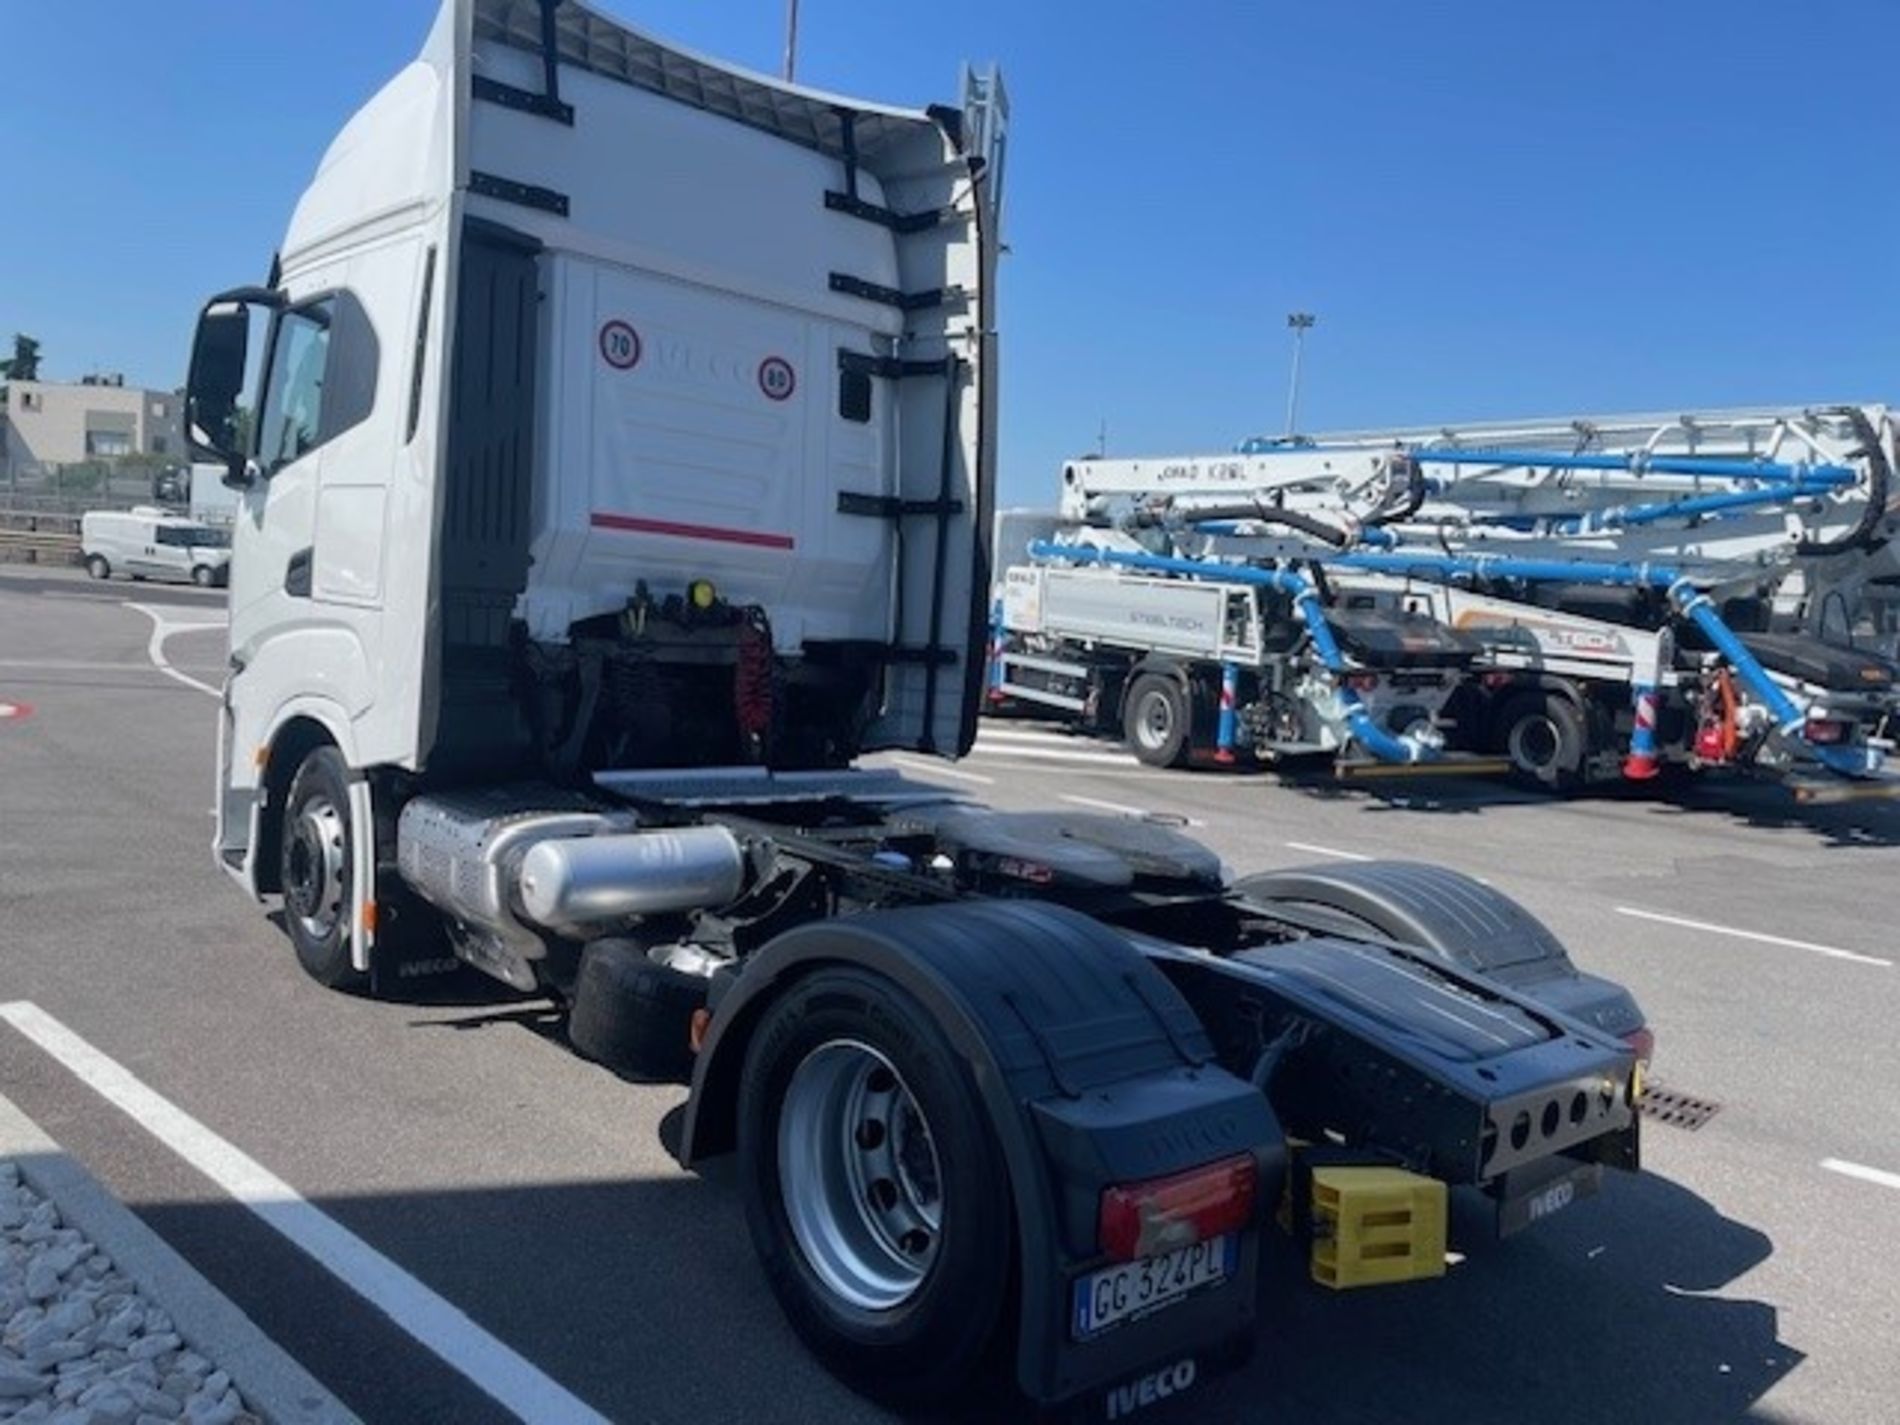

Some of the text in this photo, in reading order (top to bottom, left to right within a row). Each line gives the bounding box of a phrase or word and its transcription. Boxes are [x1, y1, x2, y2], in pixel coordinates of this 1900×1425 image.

[610, 332, 630, 357] 70
[768, 368, 786, 388] 80
[399, 958, 459, 977] IVECO
[1095, 1272, 1128, 1320] GG
[1139, 1238, 1219, 1300] 324PL
[1107, 1358, 1196, 1421] IVECO
